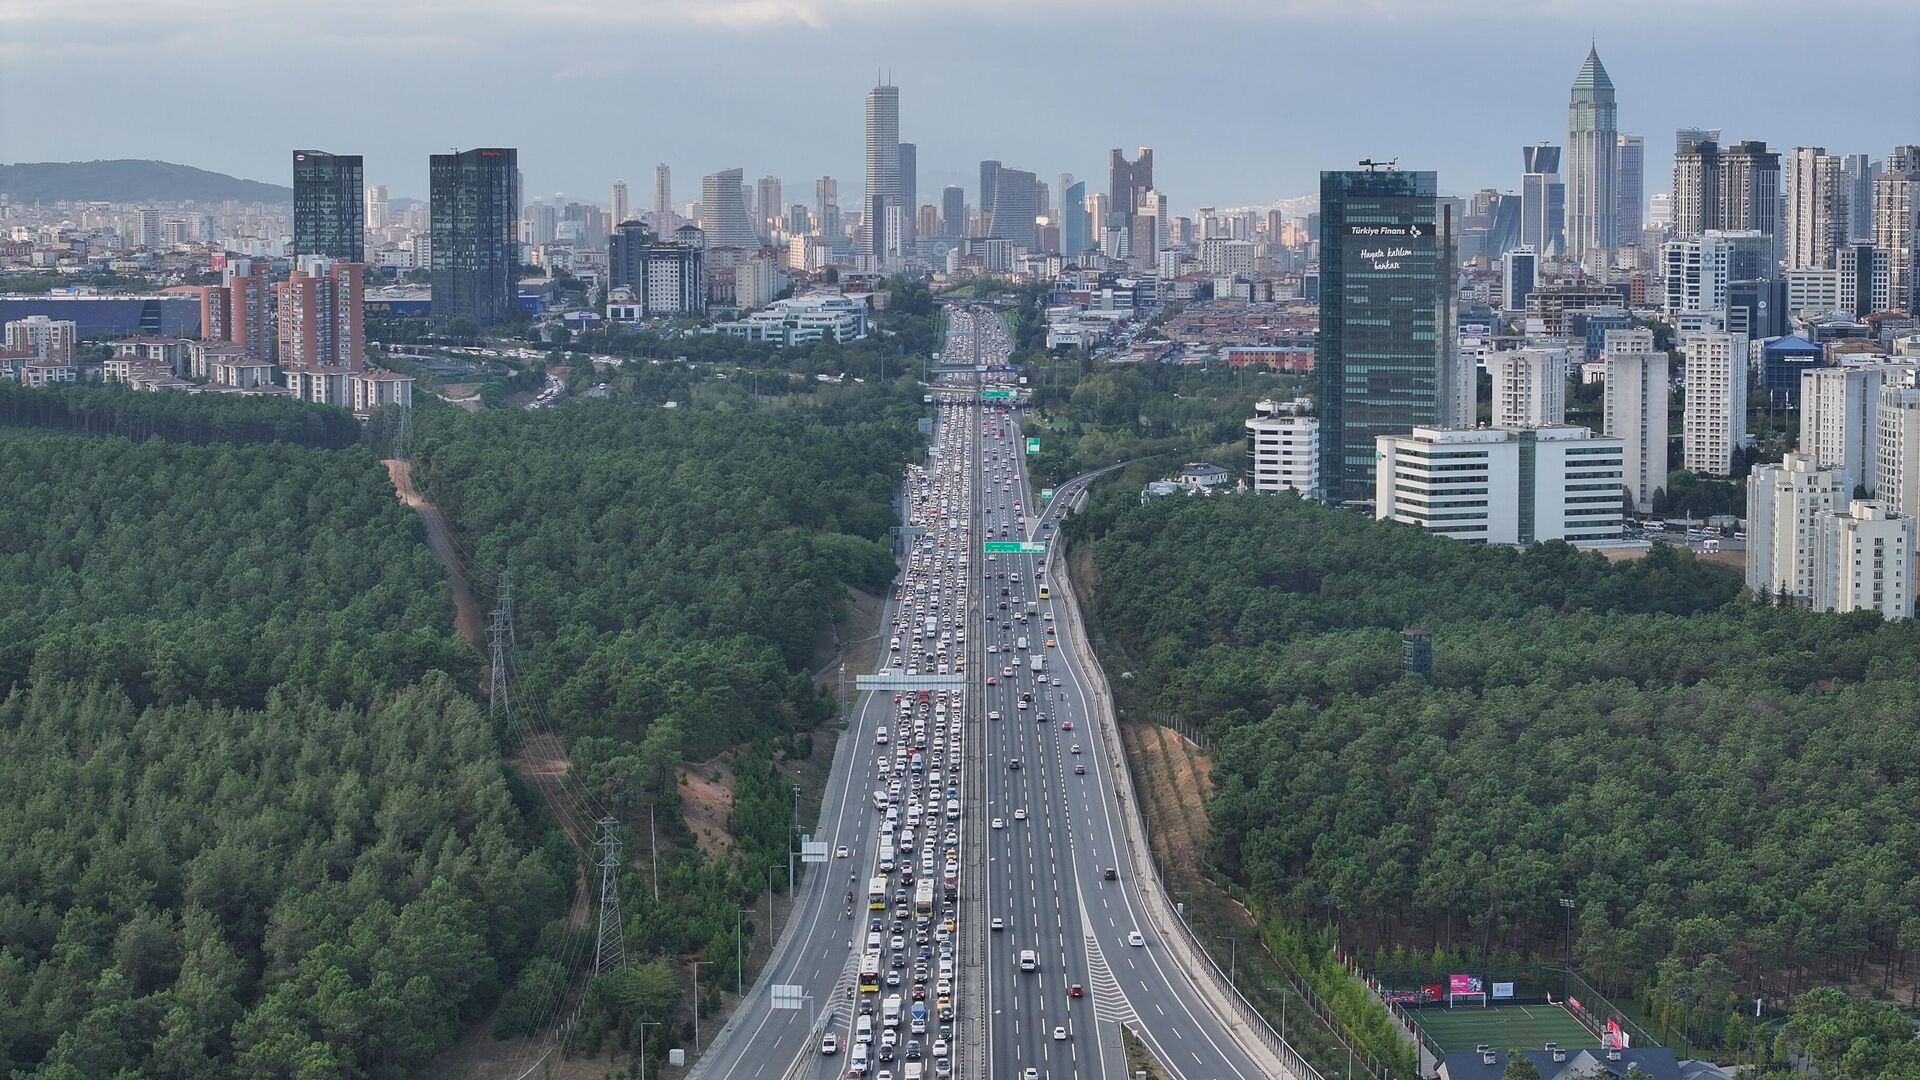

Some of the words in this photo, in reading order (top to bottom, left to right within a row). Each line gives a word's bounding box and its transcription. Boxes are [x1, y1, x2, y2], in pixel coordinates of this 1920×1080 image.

[1351, 226, 1379, 236] Türkiye
[1380, 226, 1406, 235] Finans
[1360, 248, 1386, 261] Hayata
